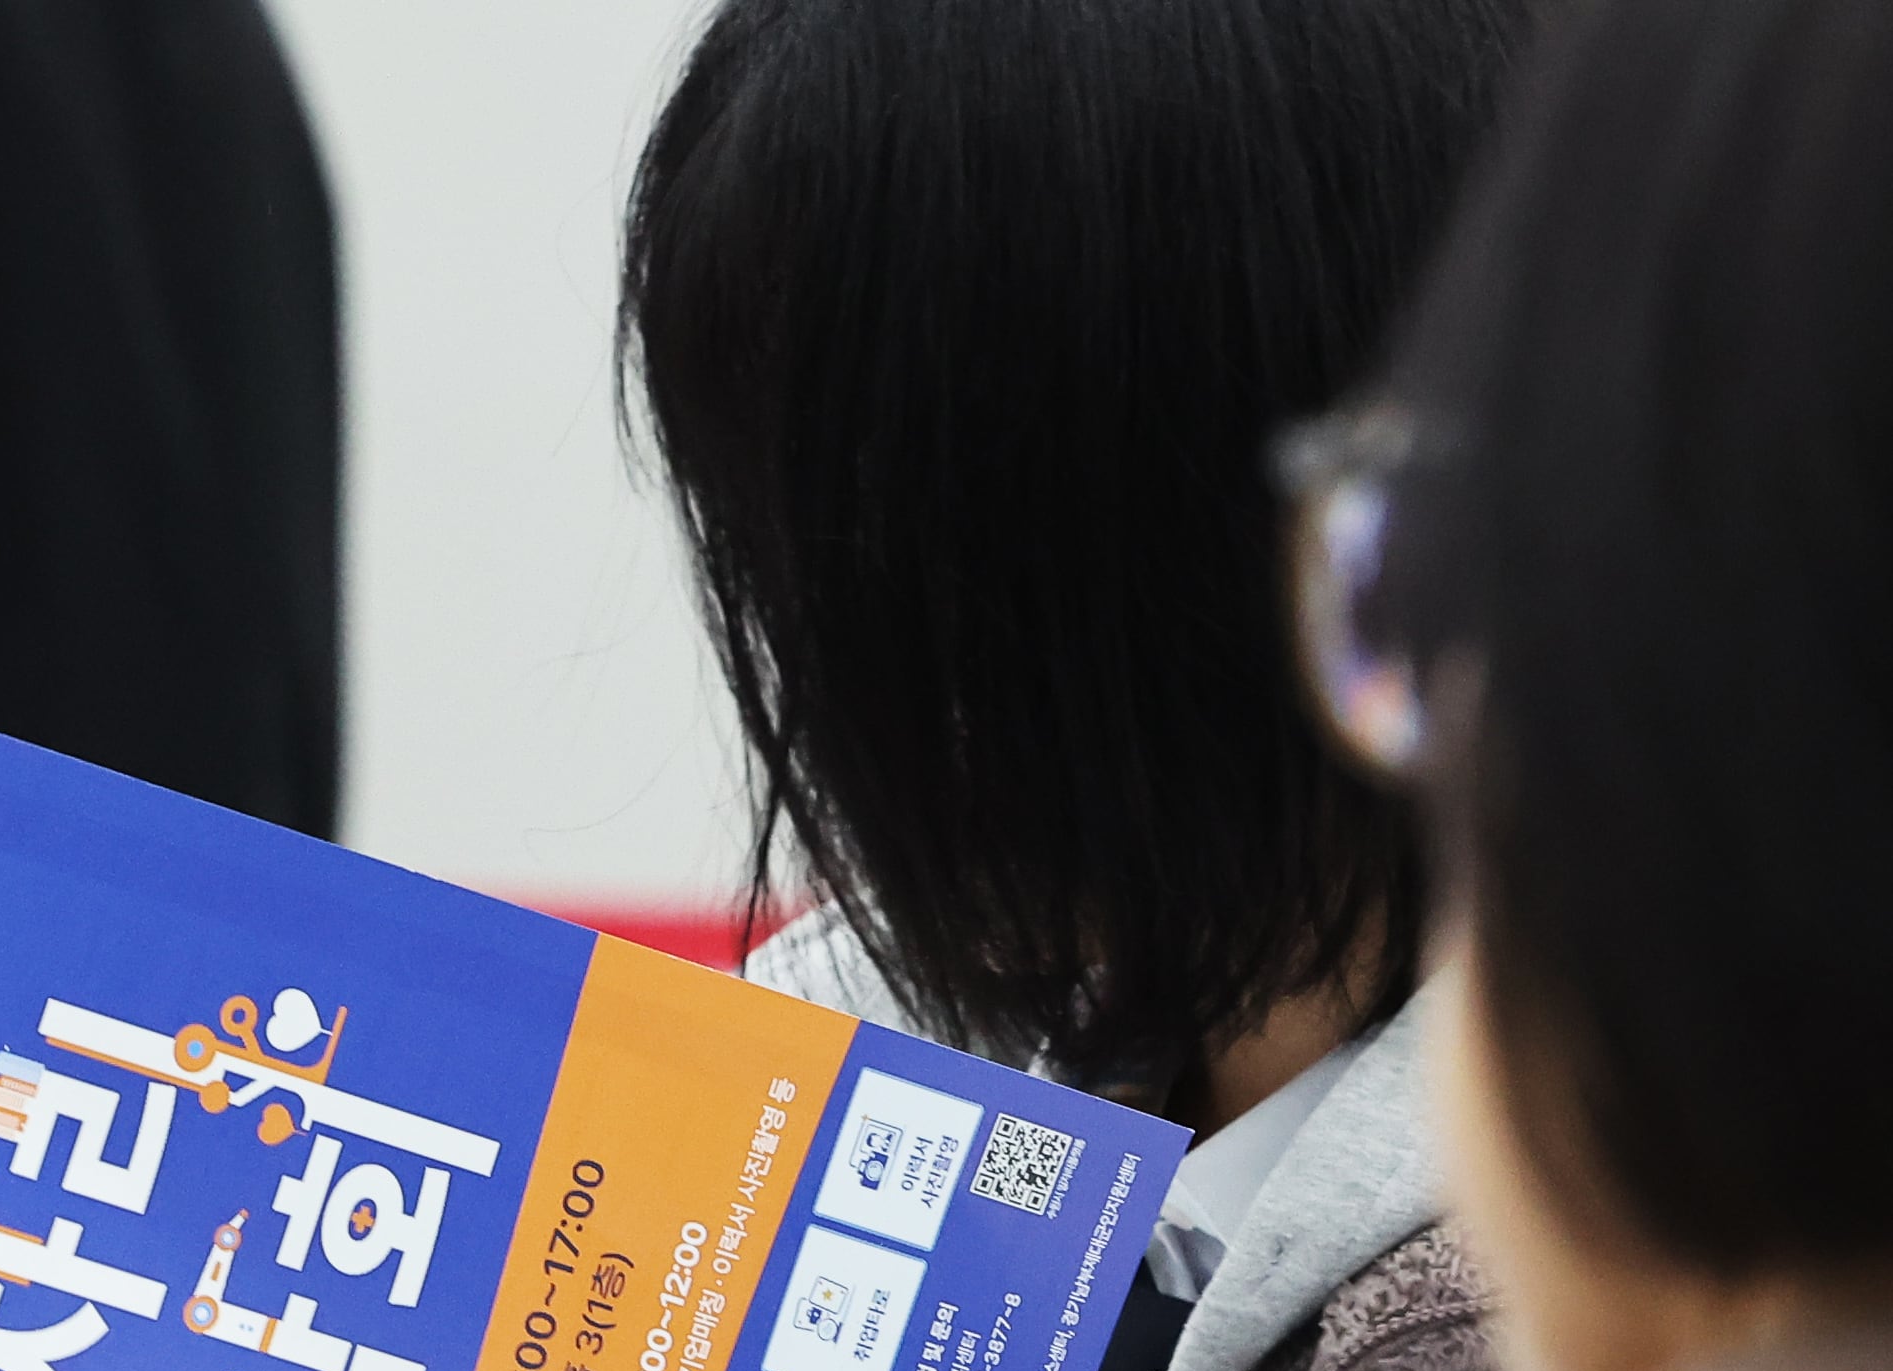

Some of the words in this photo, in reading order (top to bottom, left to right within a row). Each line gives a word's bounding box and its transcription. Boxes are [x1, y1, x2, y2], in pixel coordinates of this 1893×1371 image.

[763, 1071, 802, 1109] 등
[730, 1101, 792, 1206] 사진촬영
[900, 1136, 934, 1191] 이력서
[920, 1135, 959, 1209] 사진촬영
[704, 1198, 760, 1281] 이력서
[575, 1252, 635, 1356] 3(1층)
[853, 1289, 888, 1361] 취업타로
[925, 1297, 963, 1346] 문의
[918, 1338, 949, 1367] 및
